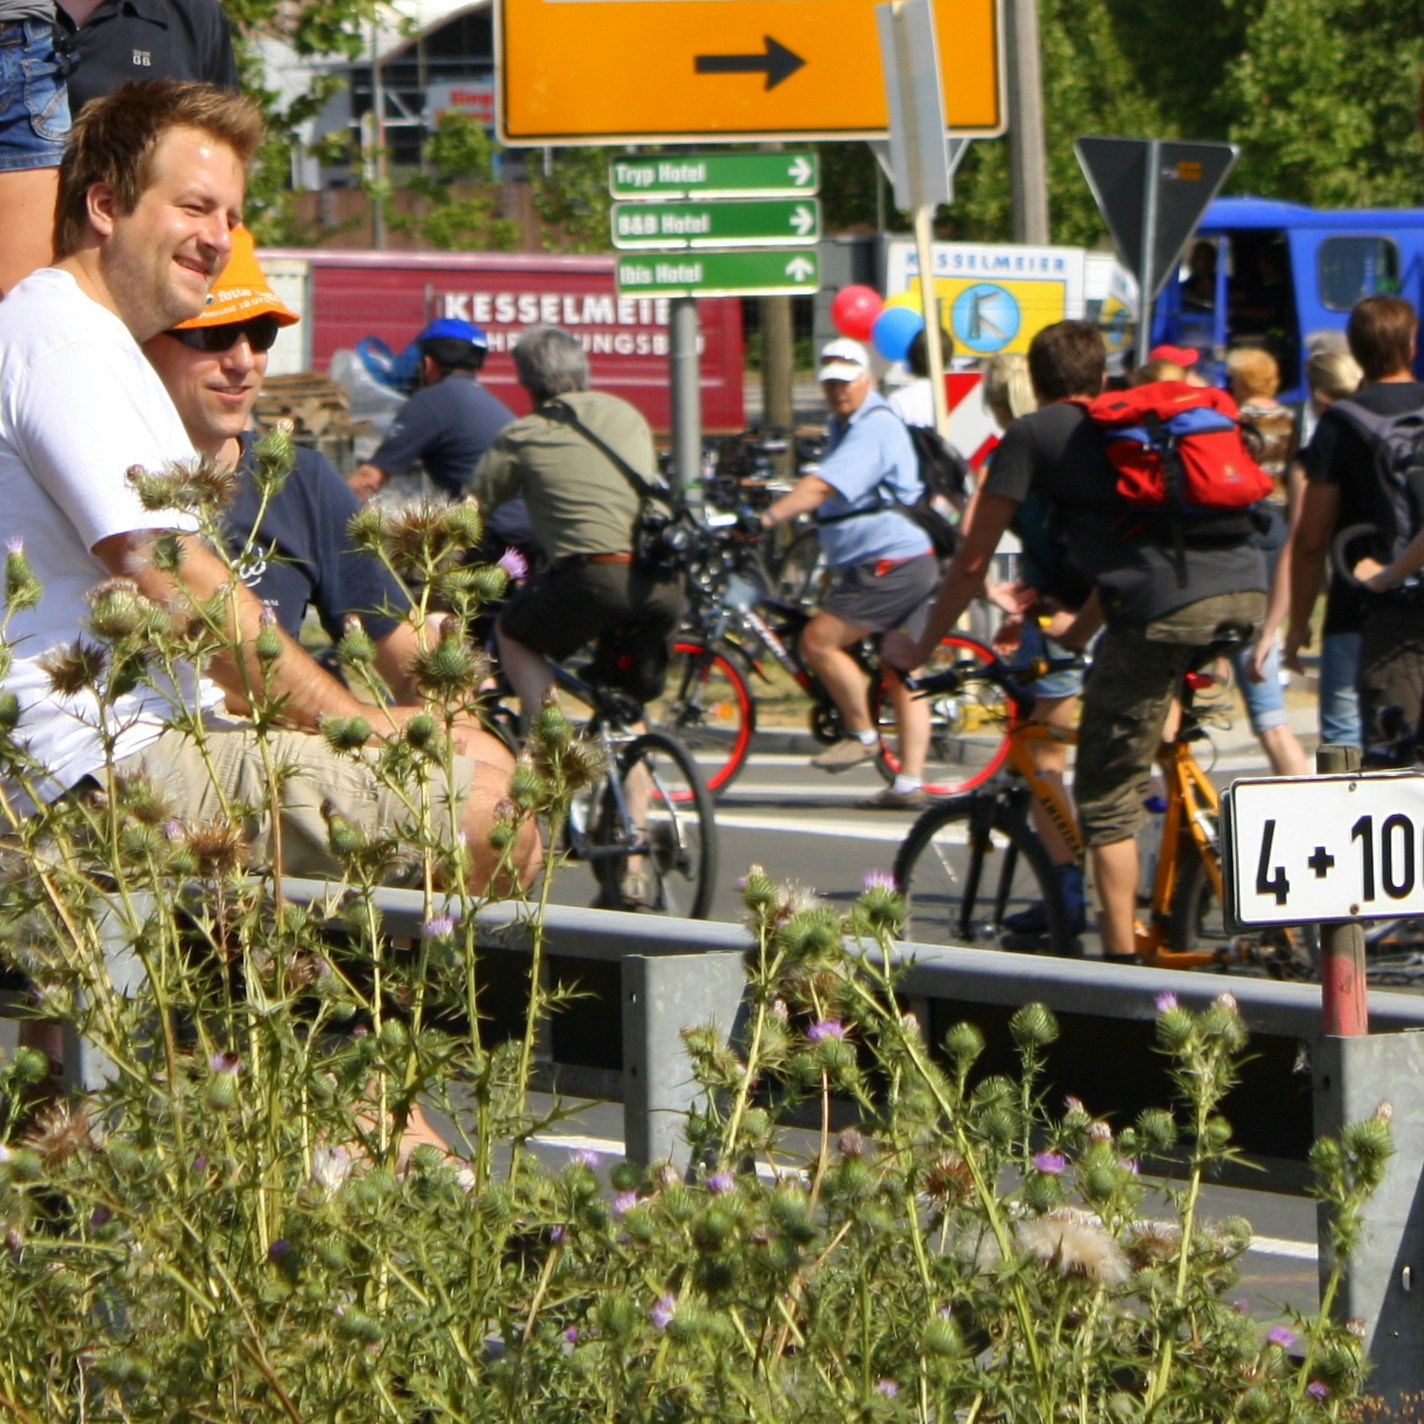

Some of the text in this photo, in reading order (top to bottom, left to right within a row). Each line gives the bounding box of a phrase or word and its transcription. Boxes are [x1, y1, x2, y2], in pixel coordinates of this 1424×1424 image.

[617, 162, 706, 187] Tryp Hotel
[661, 212, 710, 234] Hotel
[656, 262, 703, 284] Hotel
[906, 252, 1064, 272] KSSELMEIER
[444, 292, 672, 325] KESSELMEIE
